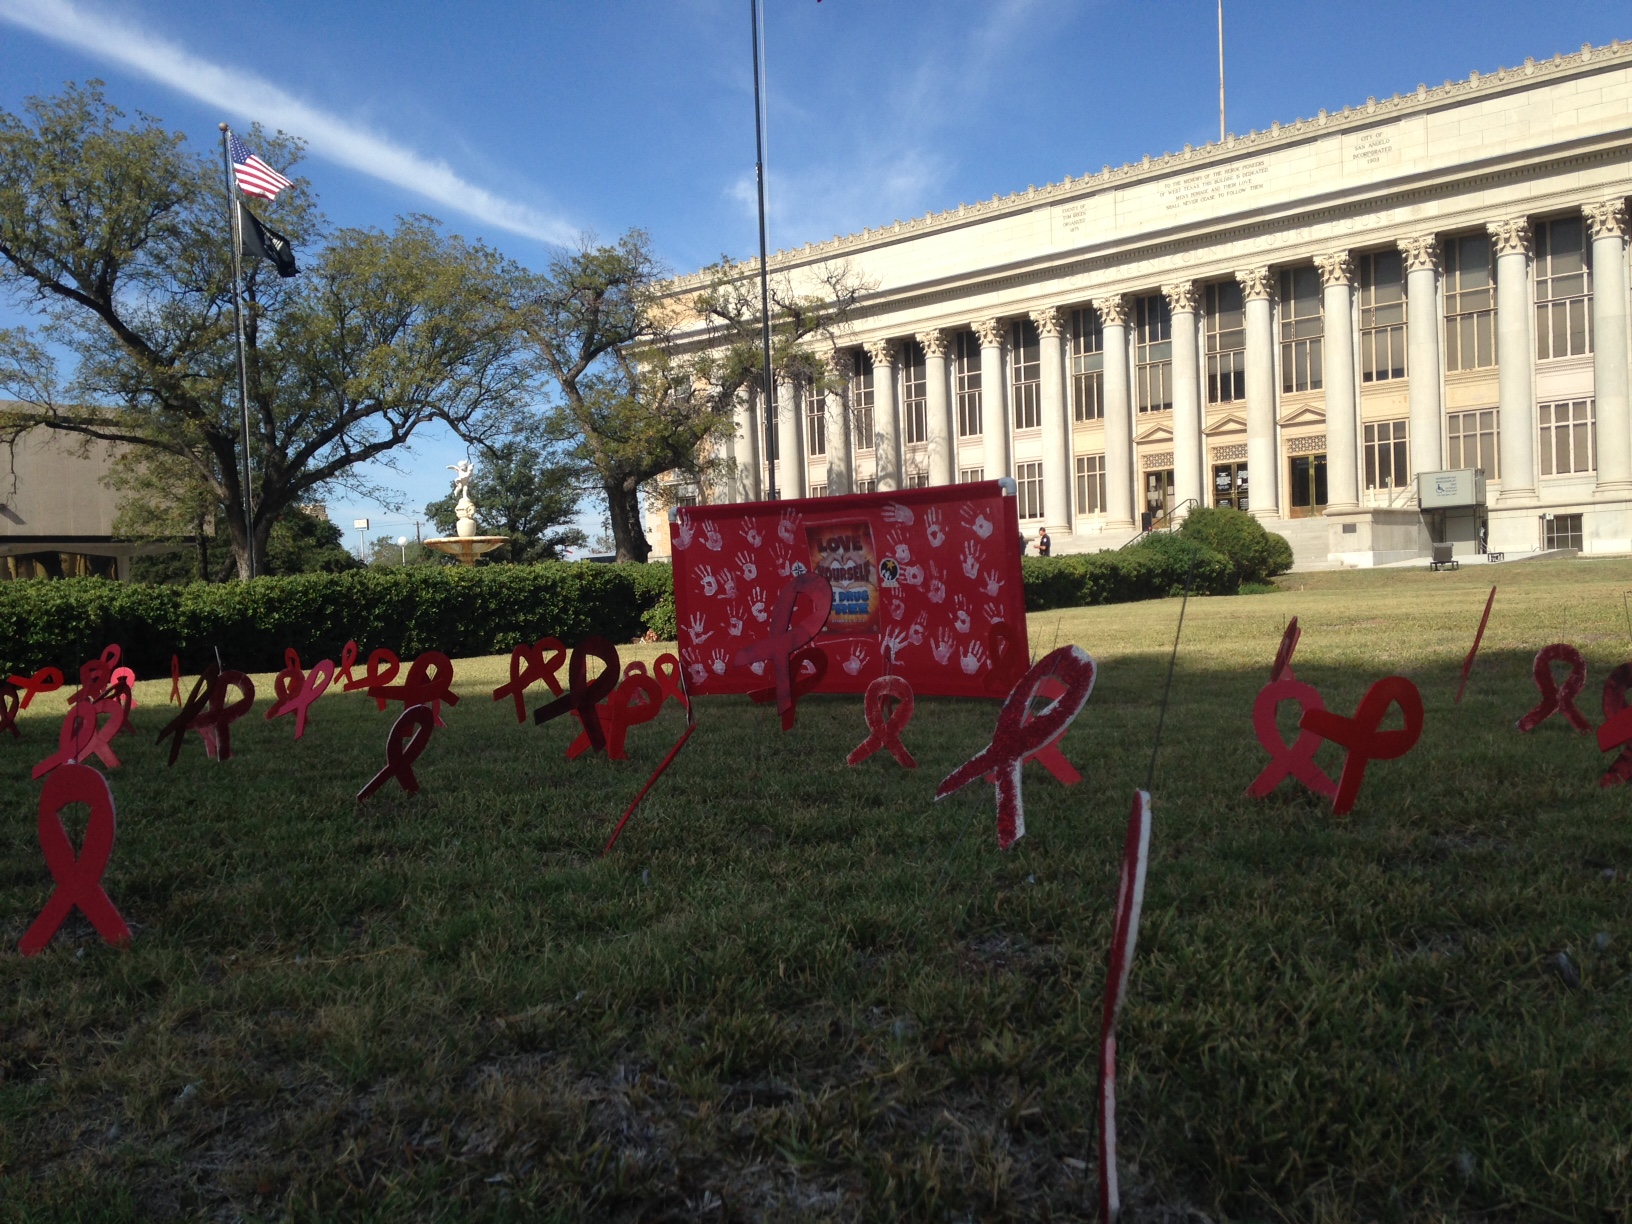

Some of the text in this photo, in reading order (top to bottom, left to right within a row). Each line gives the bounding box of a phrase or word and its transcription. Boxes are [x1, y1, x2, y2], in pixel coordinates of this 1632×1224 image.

[1368, 139, 1390, 148] ANGELO
[1352, 146, 1392, 159] INCORPORATED
[1242, 161, 1264, 170] PIONEERS
[1242, 168, 1269, 178] DEDICATED
[1226, 187, 1246, 196] FOLLOW
[816, 536, 863, 552] LOVE
[818, 562, 870, 582] YOURSELF
[839, 590, 869, 602] DRUG
